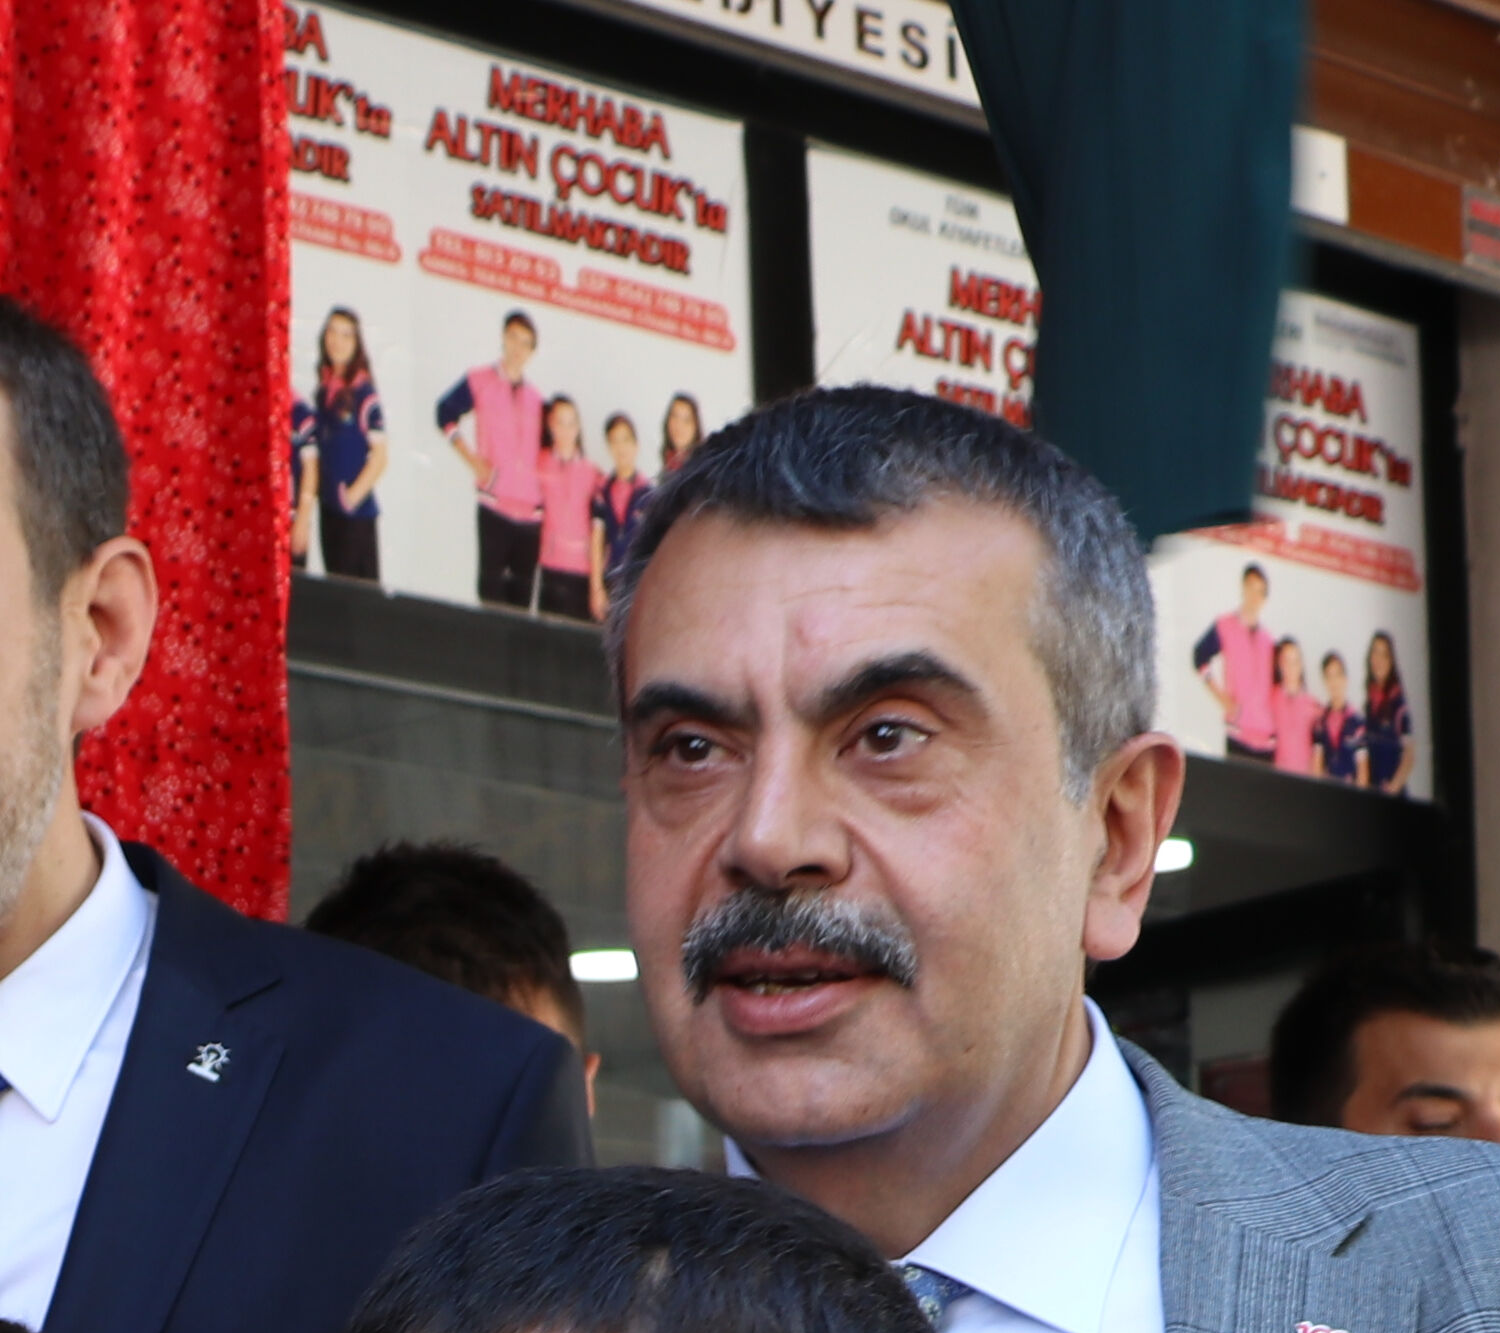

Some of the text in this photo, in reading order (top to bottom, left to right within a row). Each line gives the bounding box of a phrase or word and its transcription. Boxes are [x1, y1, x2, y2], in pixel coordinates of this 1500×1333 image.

[489, 64, 672, 160] MERHABA
[425, 108, 541, 179] ALTIN
[551, 143, 728, 234] ÇOCUK'ta
[470, 182, 691, 275] SATILMAKTADIR
[897, 307, 993, 373] ALTIN
